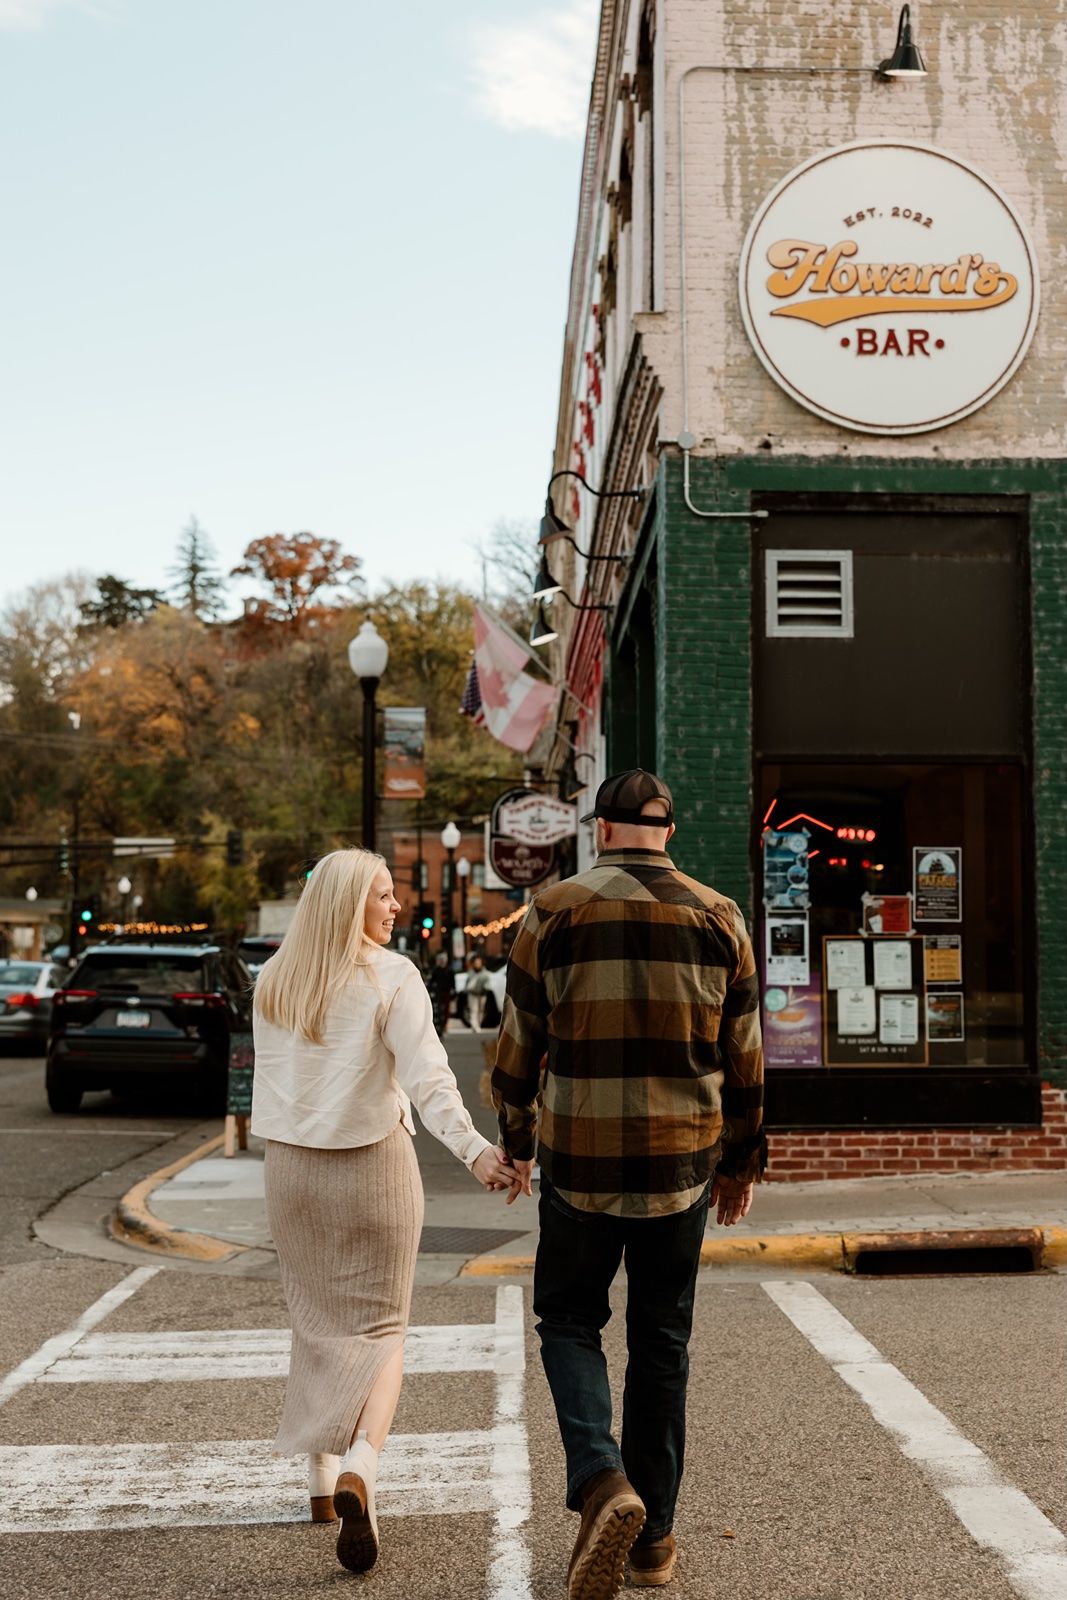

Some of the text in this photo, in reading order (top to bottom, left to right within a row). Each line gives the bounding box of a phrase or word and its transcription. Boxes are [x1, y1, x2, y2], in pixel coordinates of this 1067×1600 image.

[843, 206, 933, 228] EST. 2022
[766, 239, 1018, 299] Howard's
[856, 328, 931, 357] BAR
